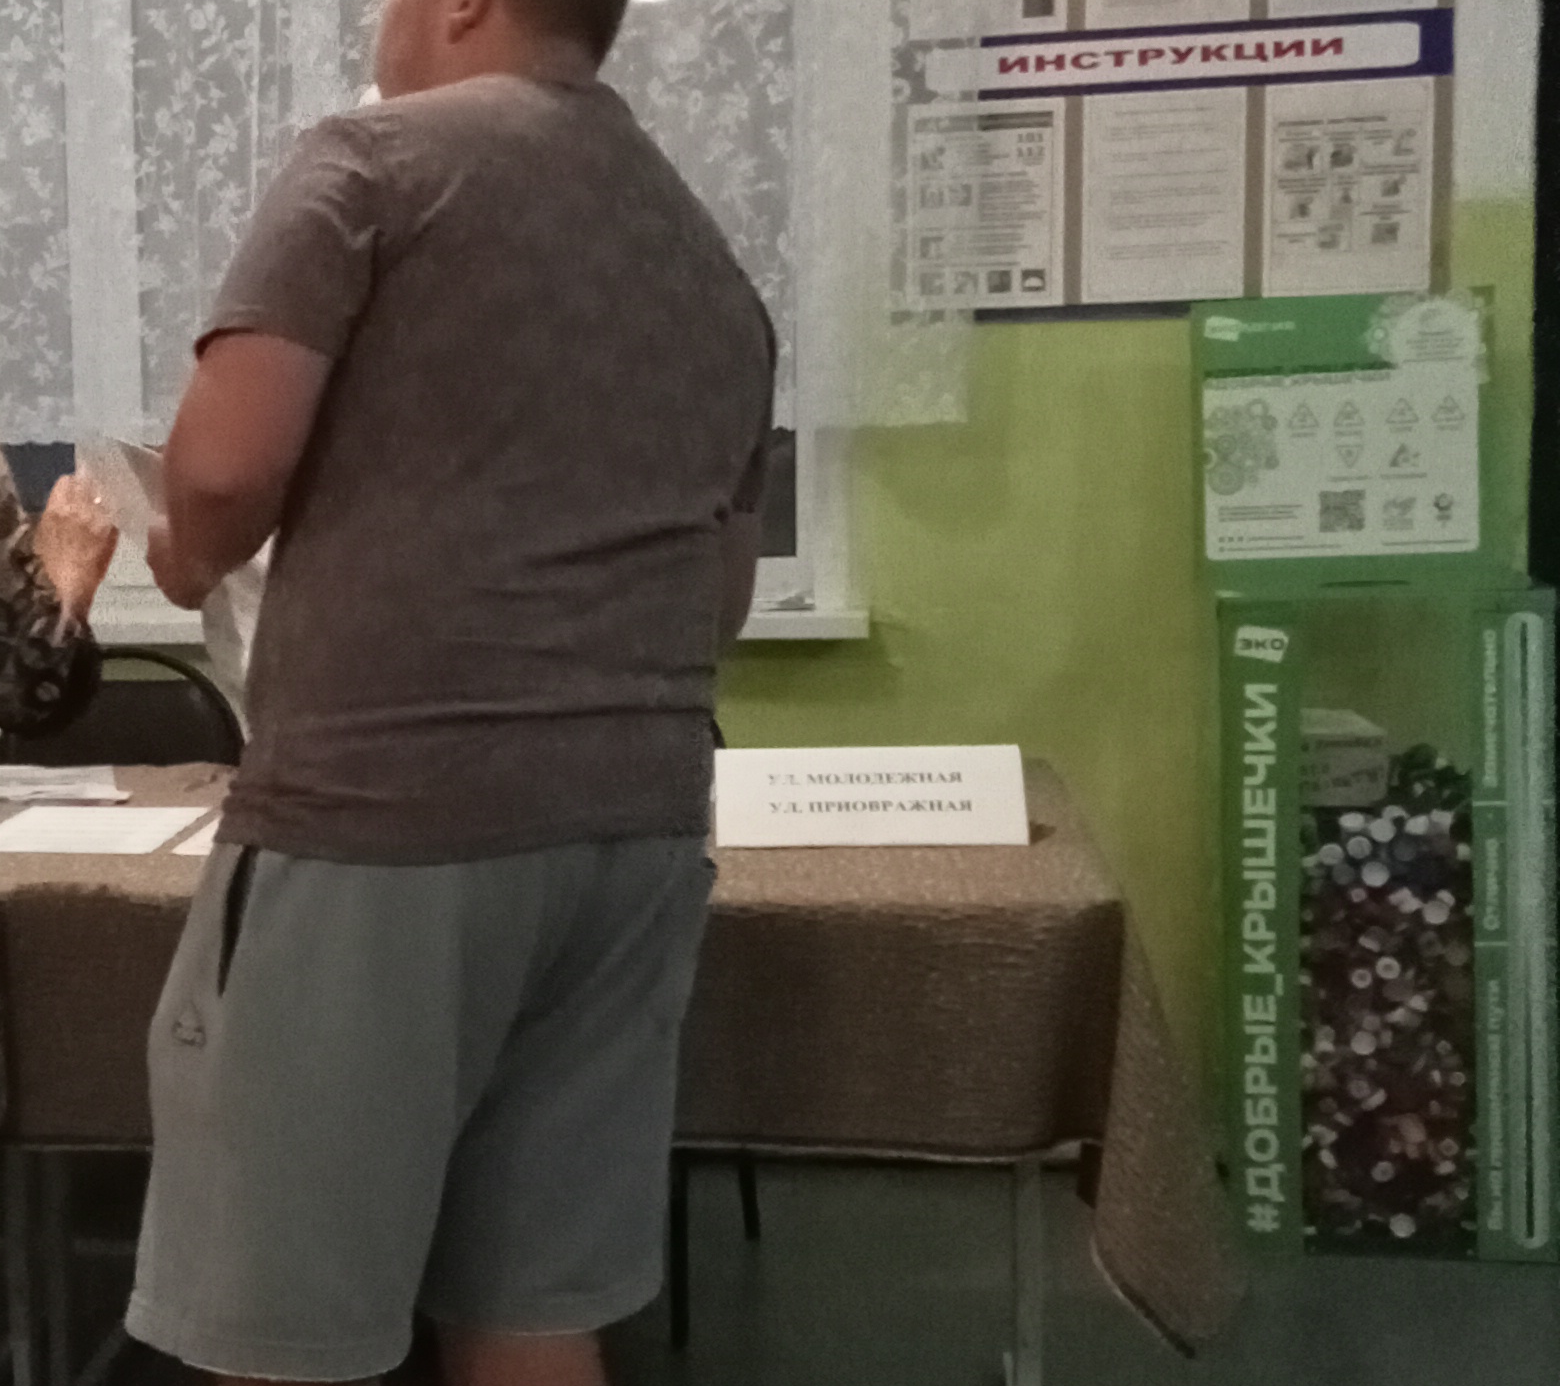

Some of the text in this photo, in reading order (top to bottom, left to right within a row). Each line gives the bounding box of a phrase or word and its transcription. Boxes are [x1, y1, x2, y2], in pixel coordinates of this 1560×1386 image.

[997, 36, 1346, 75] ИНСТРУКЦИИ
[1239, 636, 1286, 652] ЭКО
[806, 771, 963, 786] МОЛОДЕЖНАЯ
[808, 799, 973, 815] ПРИОВРАЖНАЯ
[1243, 682, 1284, 1233] #ДОБРЫЕ_КРЫШЕЧКИ
